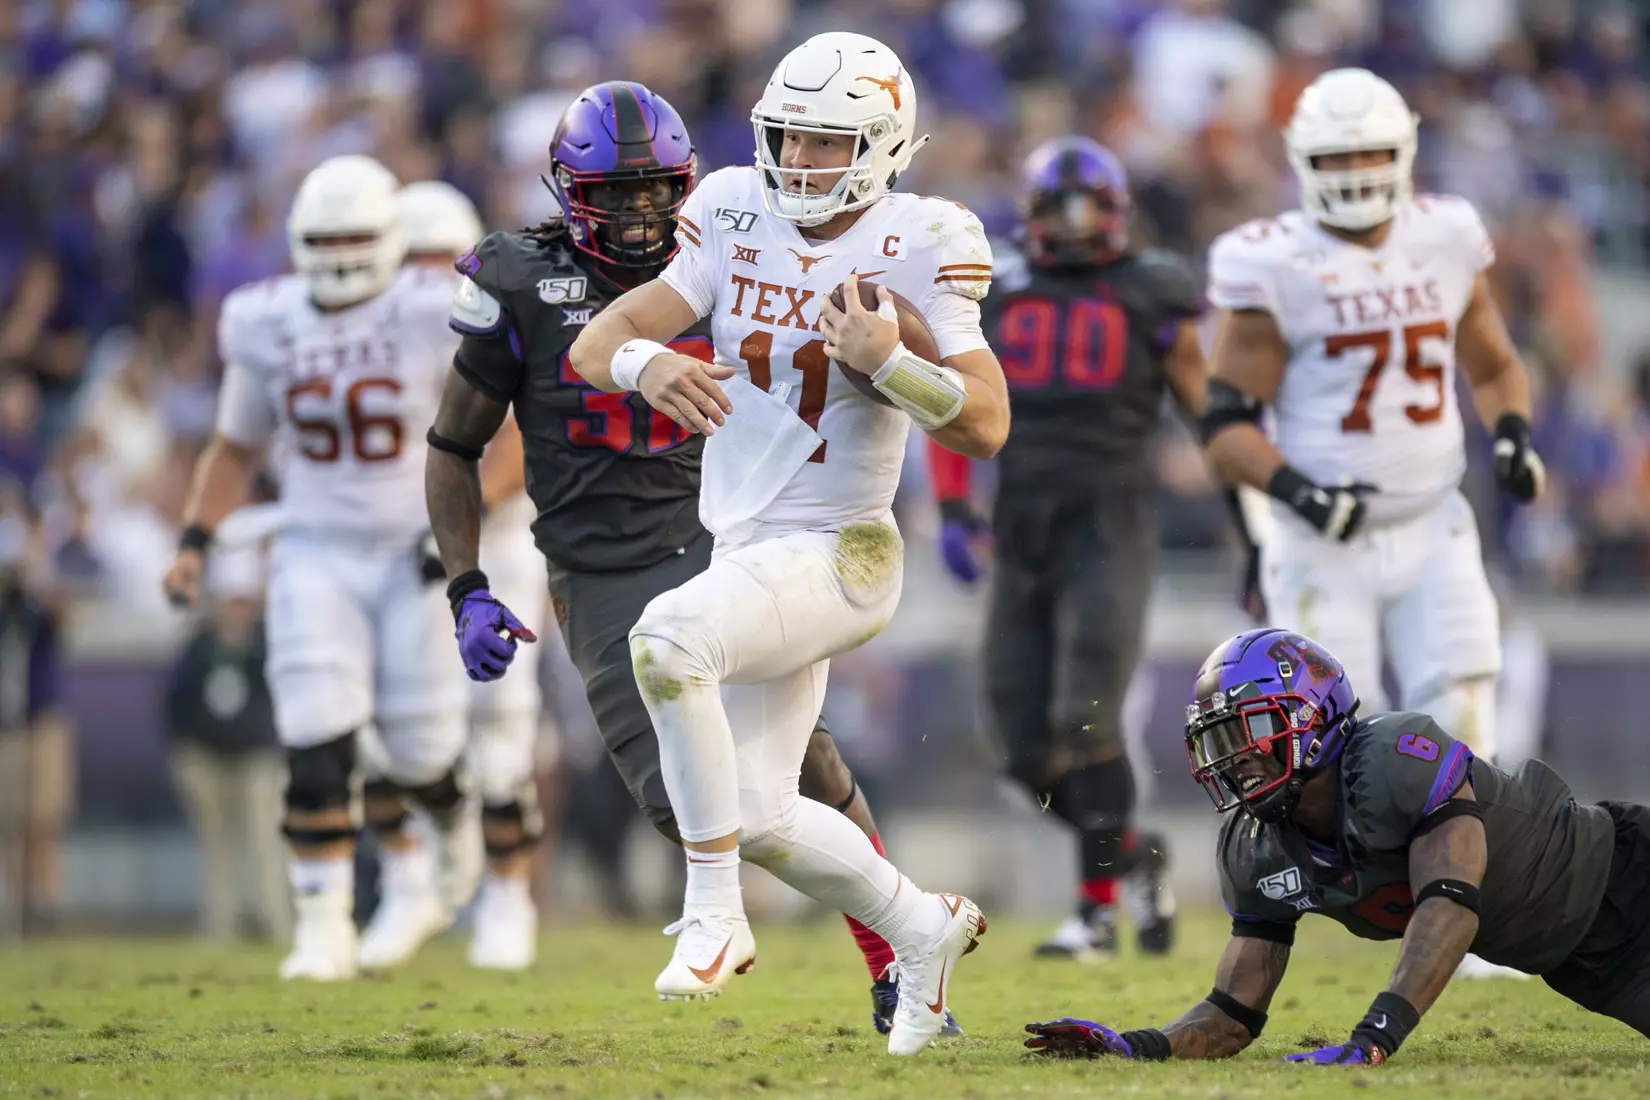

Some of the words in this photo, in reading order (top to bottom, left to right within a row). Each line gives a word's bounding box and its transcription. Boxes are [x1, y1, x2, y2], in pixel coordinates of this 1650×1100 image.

[781, 102, 807, 114] HORNS
[714, 206, 759, 234] 150
[731, 243, 762, 266] XII
[882, 234, 901, 257] C
[537, 277, 587, 304] 150
[730, 272, 822, 332] TEX
[1326, 279, 1442, 327] TEXAS
[562, 308, 594, 328] XII
[998, 295, 1129, 388] 90
[1325, 320, 1447, 434] 75
[738, 329, 831, 464] 11
[286, 377, 405, 464] 56
[1290, 711, 1300, 738] FOGS
[1396, 732, 1441, 763] 6
[1256, 866, 1302, 900] 150
